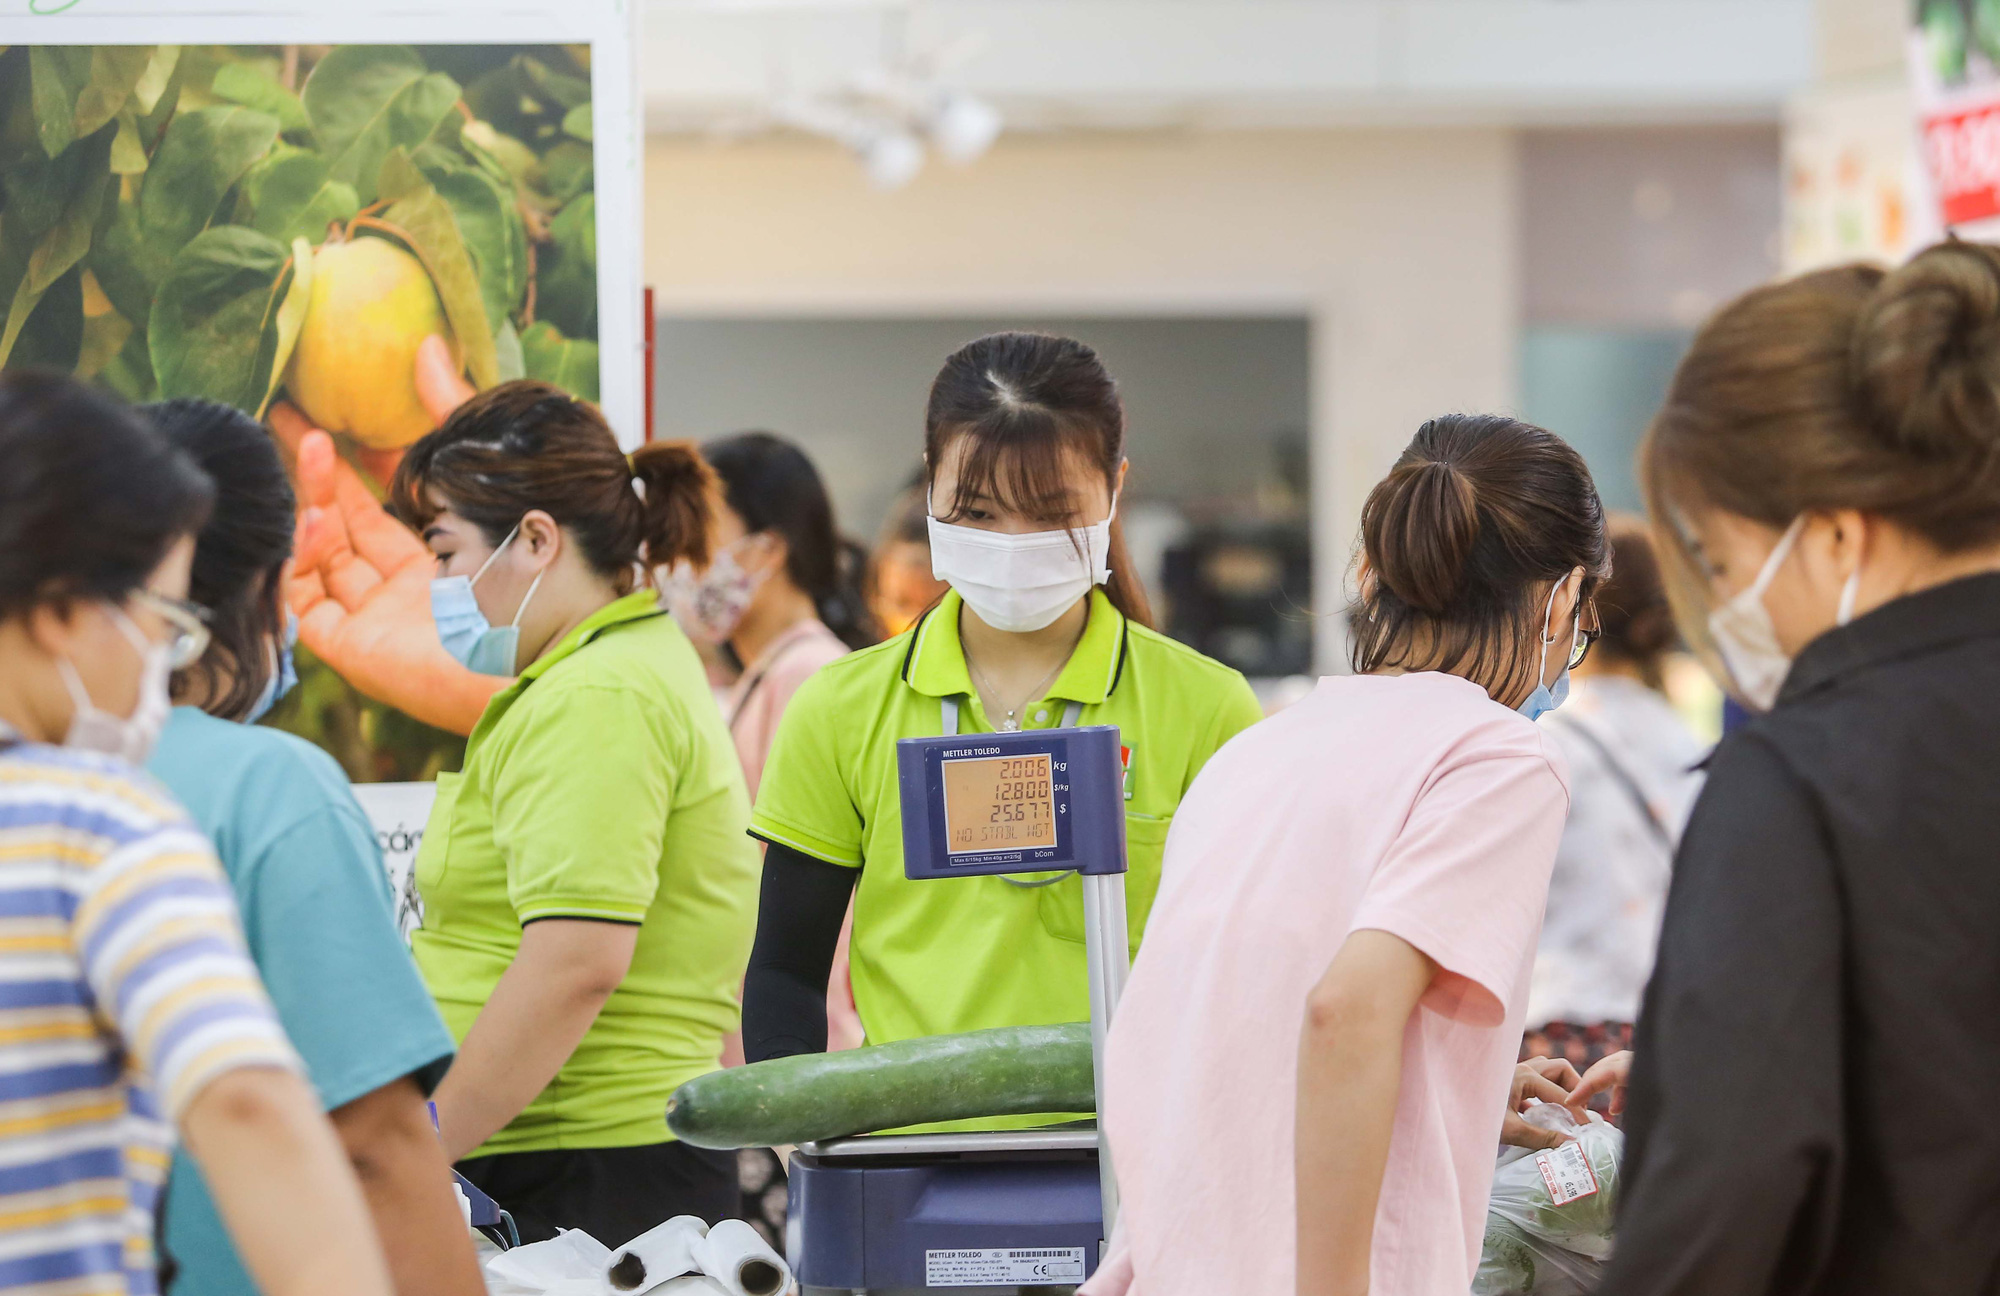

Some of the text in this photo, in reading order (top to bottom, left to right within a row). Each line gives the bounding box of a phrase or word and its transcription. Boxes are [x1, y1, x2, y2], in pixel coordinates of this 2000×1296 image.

[943, 747, 1000, 758] METTLER TOLEDO
[1000, 759, 1047, 779] 2.006
[1053, 761, 1067, 772] kg
[995, 780, 1048, 801] 12.800
[1054, 784, 1069, 792] $/kg
[990, 801, 1050, 822] 25.677
[1059, 803, 1067, 815] $
[1034, 850, 1054, 858] bCom
